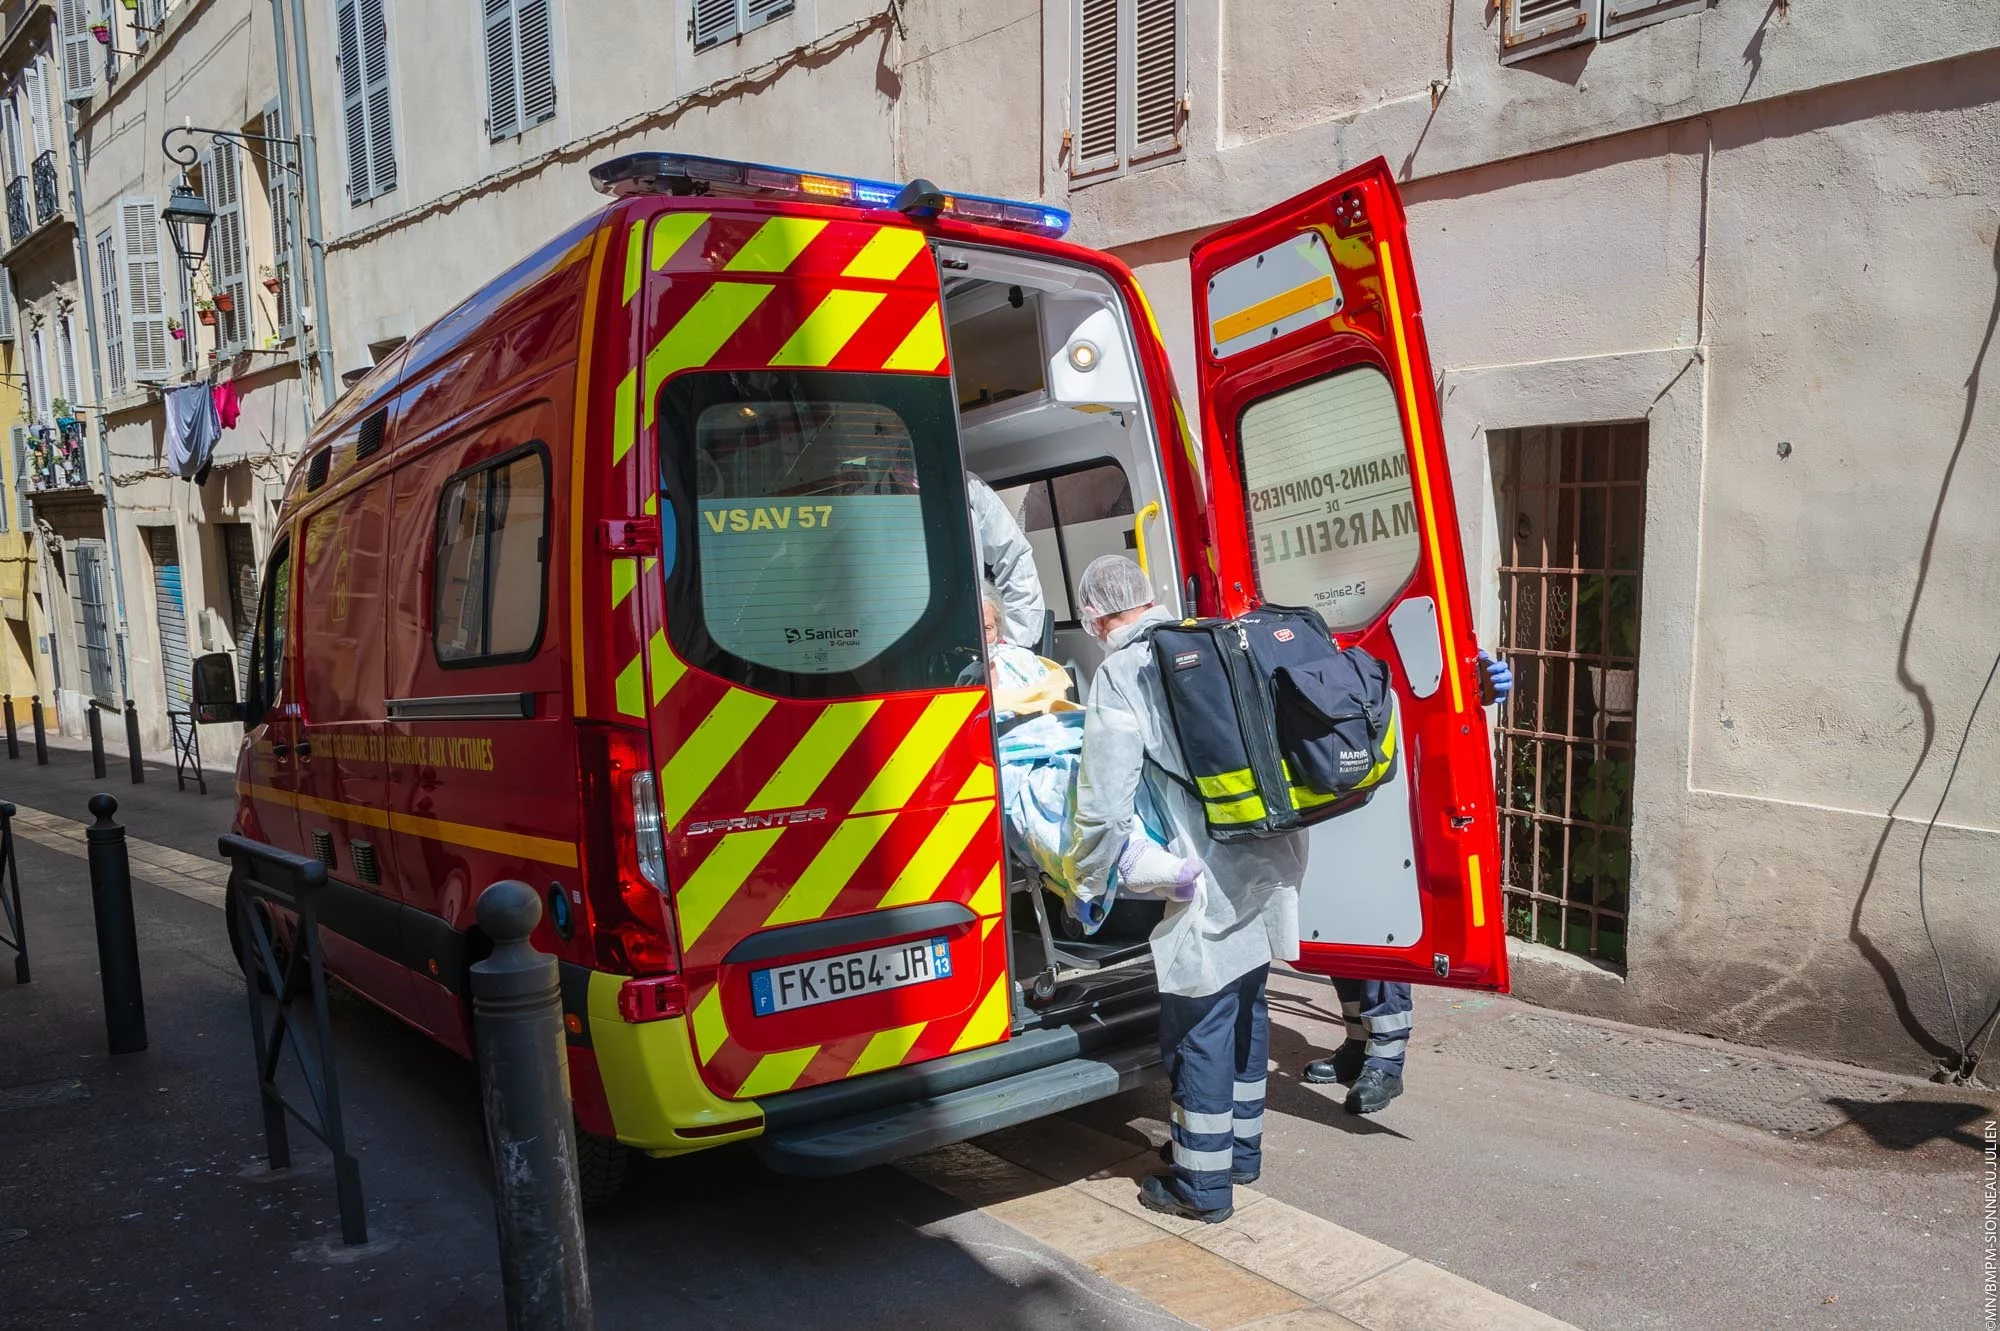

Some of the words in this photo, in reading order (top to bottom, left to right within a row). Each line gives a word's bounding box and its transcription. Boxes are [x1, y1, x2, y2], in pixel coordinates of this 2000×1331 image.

[704, 507, 791, 533] VSAV
[798, 505, 833, 528] 57
[804, 628, 859, 640] Sanicar
[429, 737, 447, 767] AUX
[448, 737, 494, 772] VICTIMES
[687, 808, 828, 836] SPRINTER
[760, 997, 768, 1007] F
[778, 945, 929, 1005] FK-664-JR
[934, 957, 950, 975] 13
